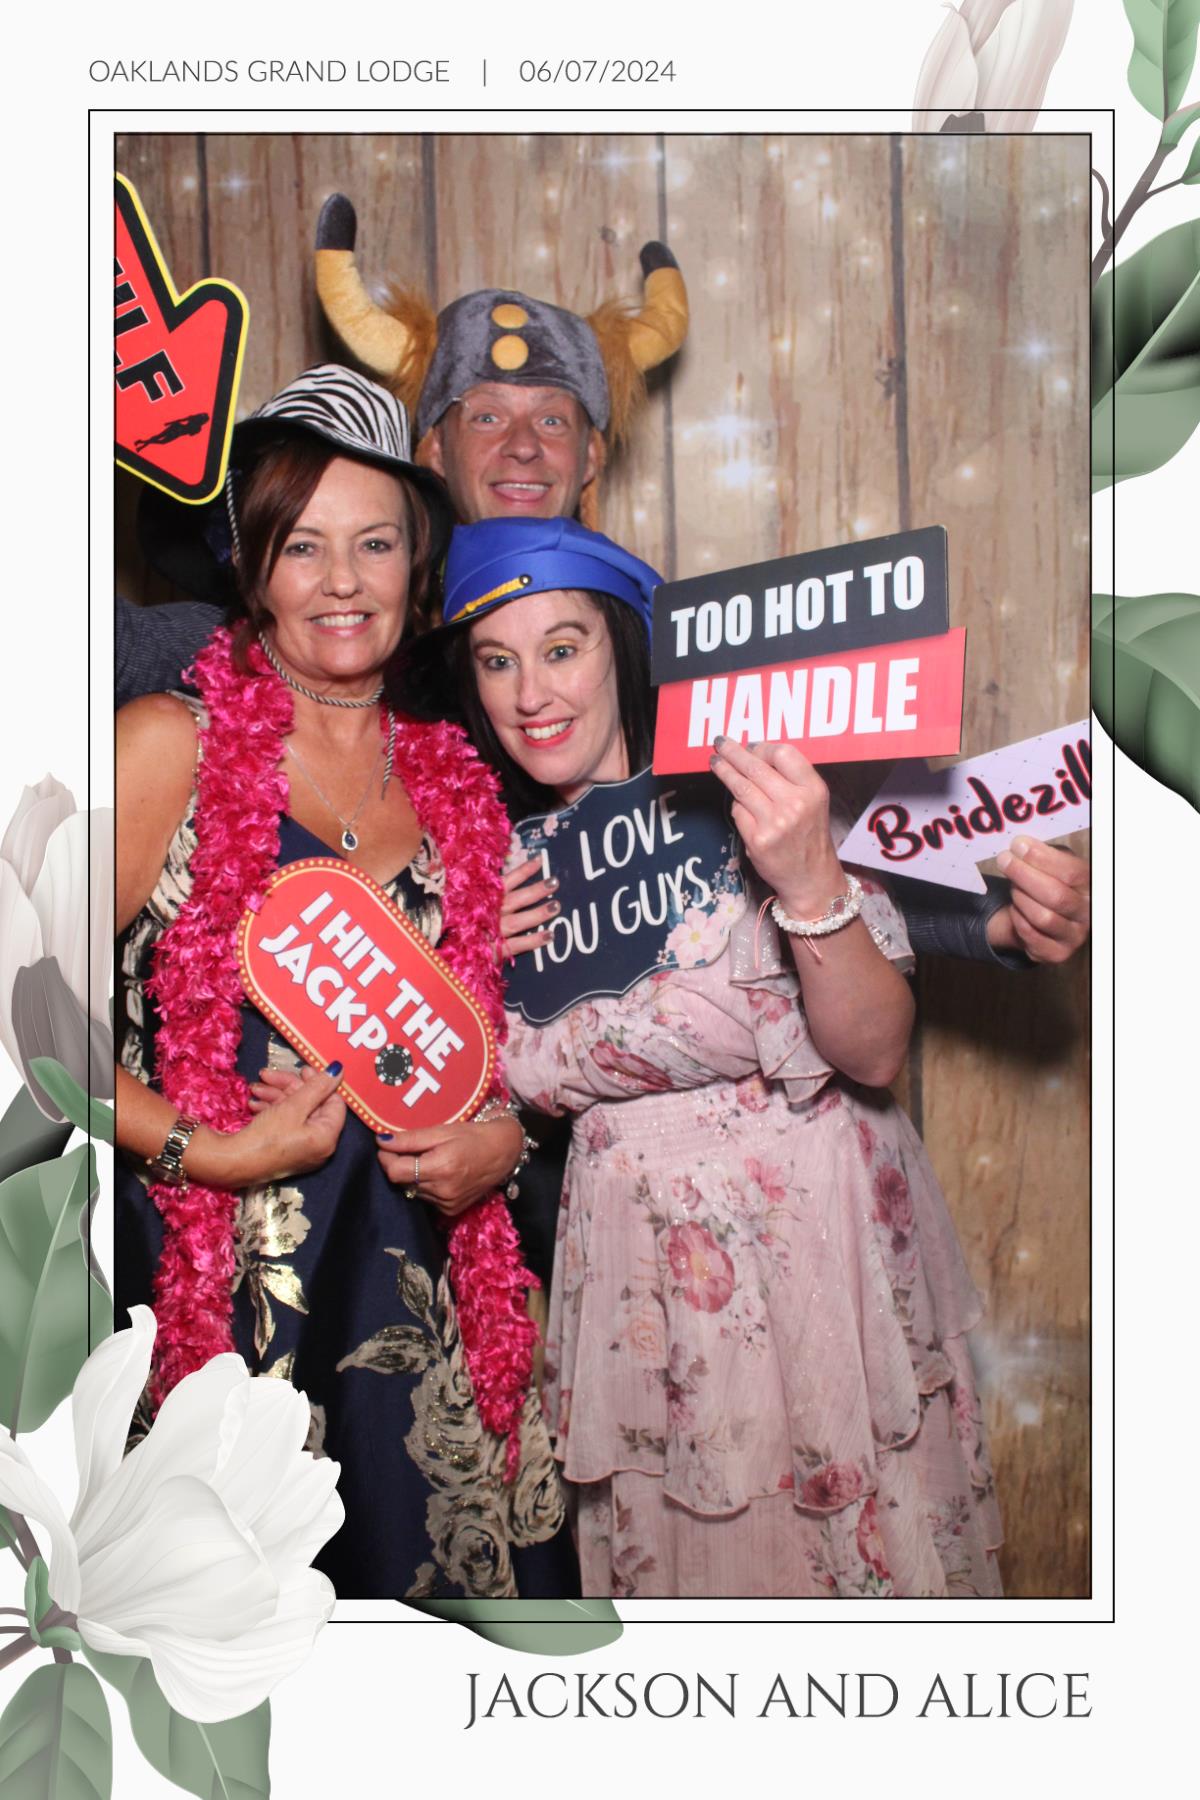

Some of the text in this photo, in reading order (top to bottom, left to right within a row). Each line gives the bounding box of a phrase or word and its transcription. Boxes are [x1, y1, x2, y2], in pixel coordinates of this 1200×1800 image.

[670, 555, 925, 658] TOO HOT TO
[687, 657, 920, 748] HANDLE
[579, 790, 684, 881] LOVE
[611, 857, 712, 935] GUYS
[299, 890, 465, 1072] I HIT THE
